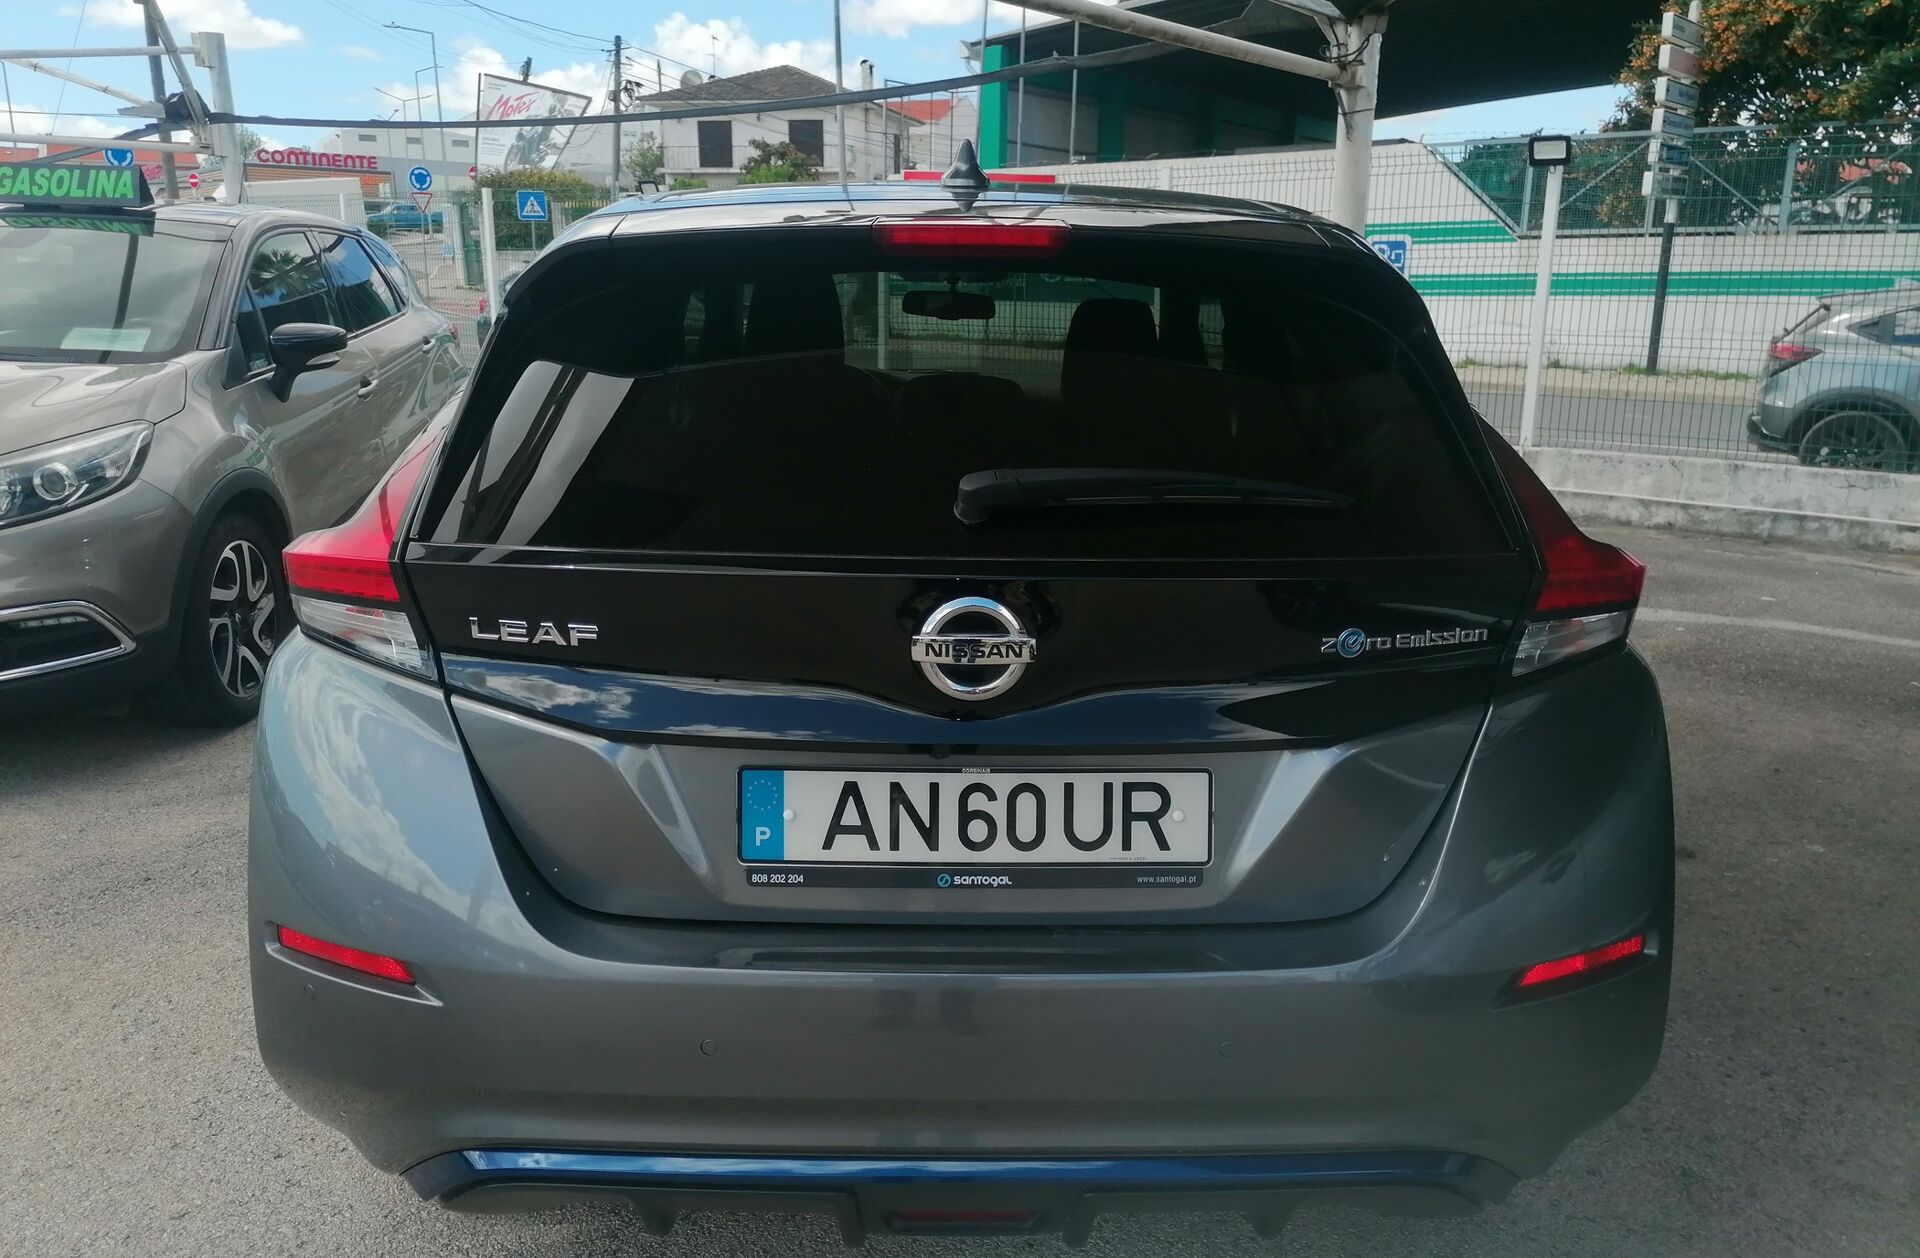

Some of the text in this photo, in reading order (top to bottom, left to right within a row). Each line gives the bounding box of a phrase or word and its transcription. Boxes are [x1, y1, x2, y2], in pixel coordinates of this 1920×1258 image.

[256, 148, 378, 170] CONTINENTE
[0, 166, 134, 199] GASOLINA
[469, 616, 599, 647] LEAF
[1396, 627, 1489, 649] Emission
[924, 641, 1023, 660] NISSAN
[755, 826, 771, 847] P
[751, 873, 804, 884] 808 202 204
[1136, 875, 1197, 885] www.santogal.pt
